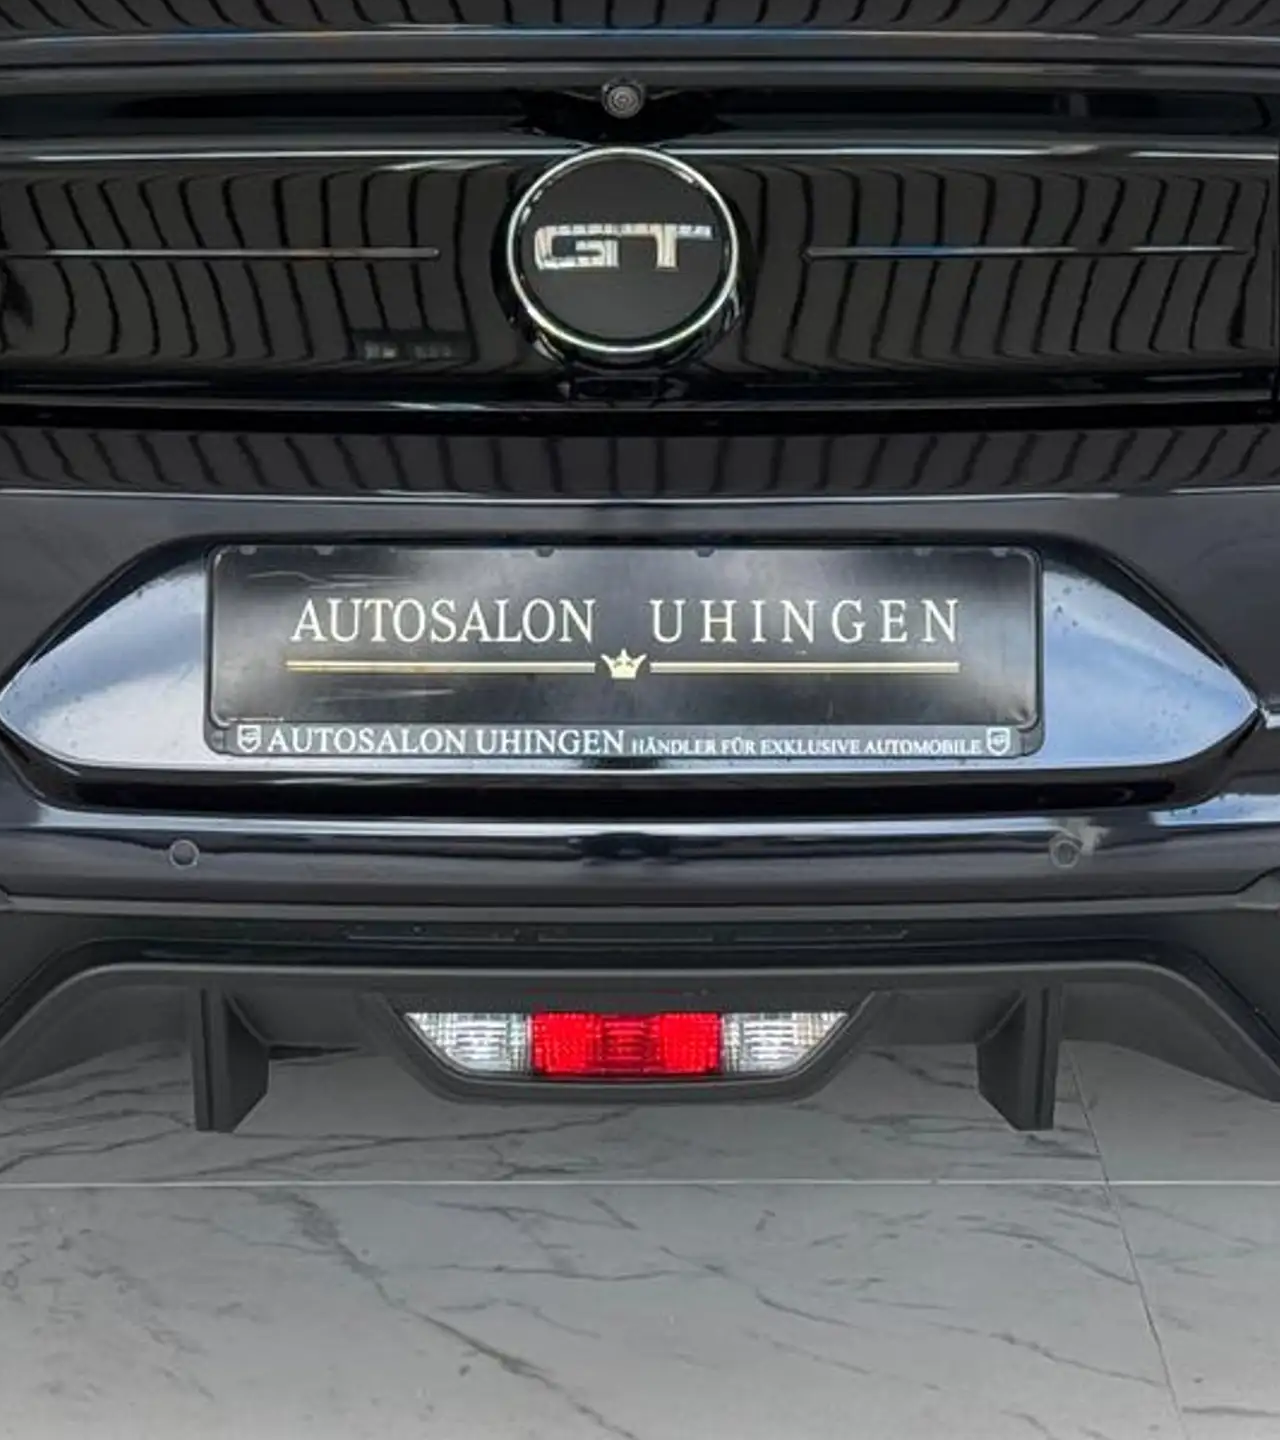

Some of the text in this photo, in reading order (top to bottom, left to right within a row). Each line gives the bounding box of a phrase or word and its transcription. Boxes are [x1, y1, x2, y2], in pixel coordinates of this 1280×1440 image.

[534, 223, 714, 271] GT
[290, 597, 959, 644] AUTOSALON UHINGEN
[267, 727, 467, 754] AUTOSALON
[476, 728, 625, 755] UHINGEN
[632, 734, 717, 756] HÄNDLER
[722, 734, 757, 756] FÜR
[760, 738, 862, 756] EXKLUSIVE
[864, 738, 982, 756] AUTOMOBILE
